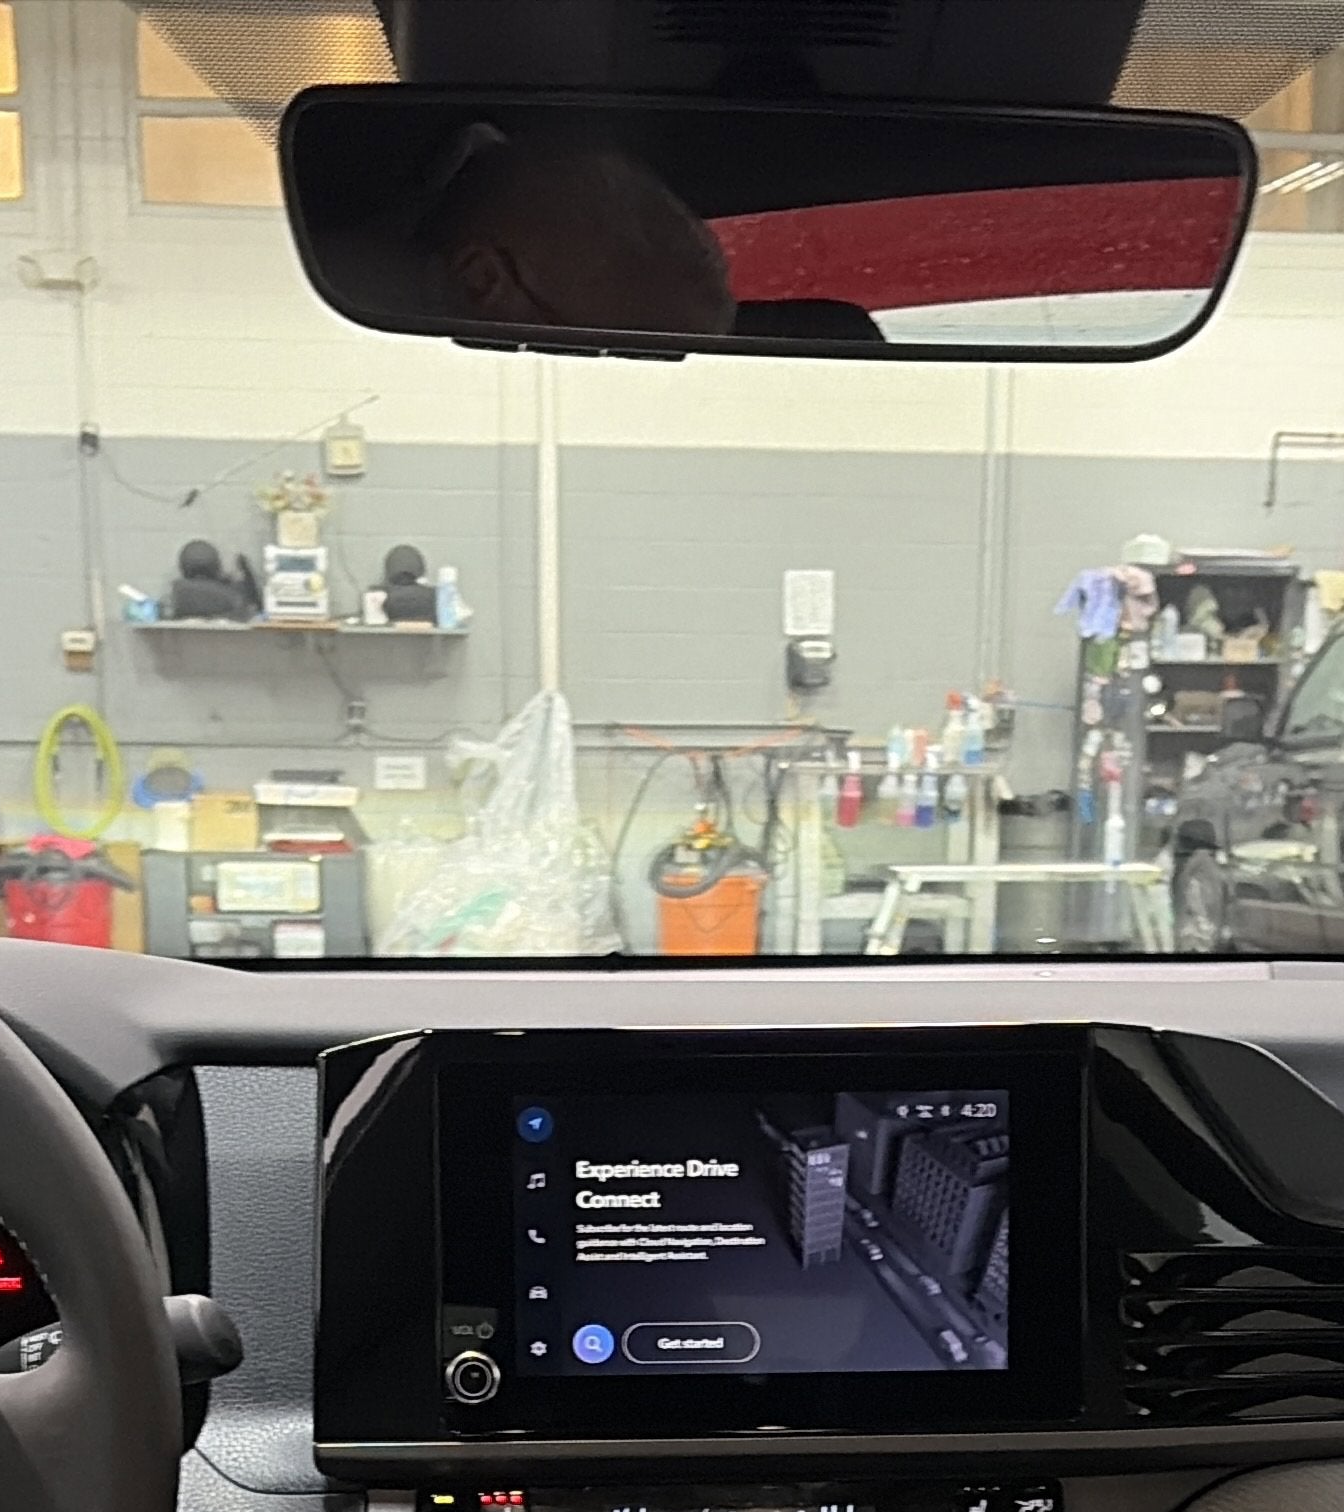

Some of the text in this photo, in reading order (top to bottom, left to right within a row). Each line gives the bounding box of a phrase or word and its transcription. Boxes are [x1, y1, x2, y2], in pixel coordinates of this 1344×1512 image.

[960, 1103, 998, 1118] 4:20
[576, 1159, 740, 1182] Experience Drive
[576, 1191, 662, 1209] Connect
[657, 1337, 724, 1350] Get started
